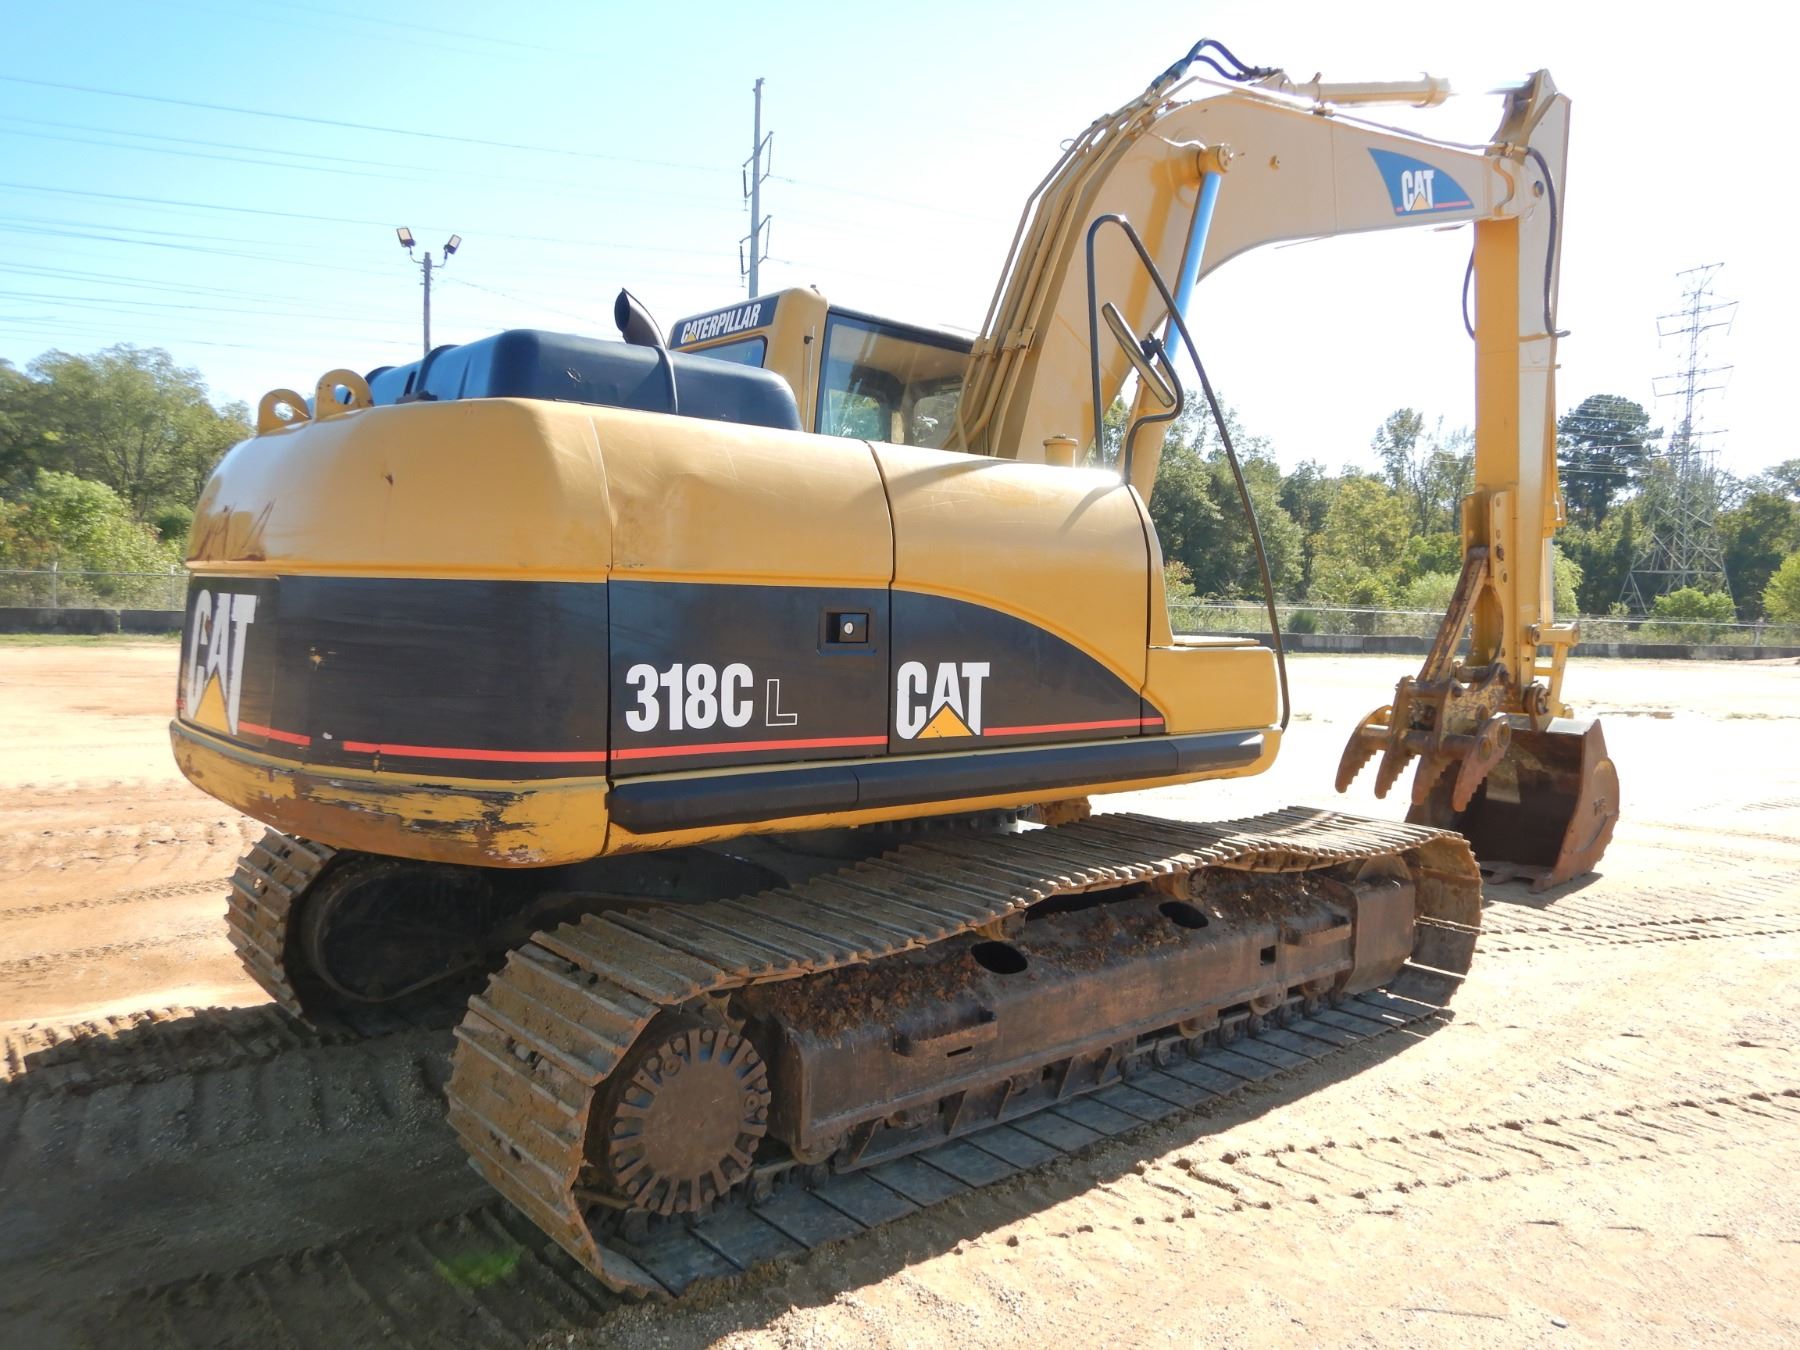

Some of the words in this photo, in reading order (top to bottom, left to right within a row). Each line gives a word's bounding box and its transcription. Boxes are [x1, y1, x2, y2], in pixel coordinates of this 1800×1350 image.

[1401, 169, 1435, 212] CAT
[680, 303, 762, 344] CATERPILLAR
[186, 588, 257, 736] CAT
[625, 662, 754, 732] 318C
[765, 678, 798, 727] L
[896, 661, 990, 740] CAT
